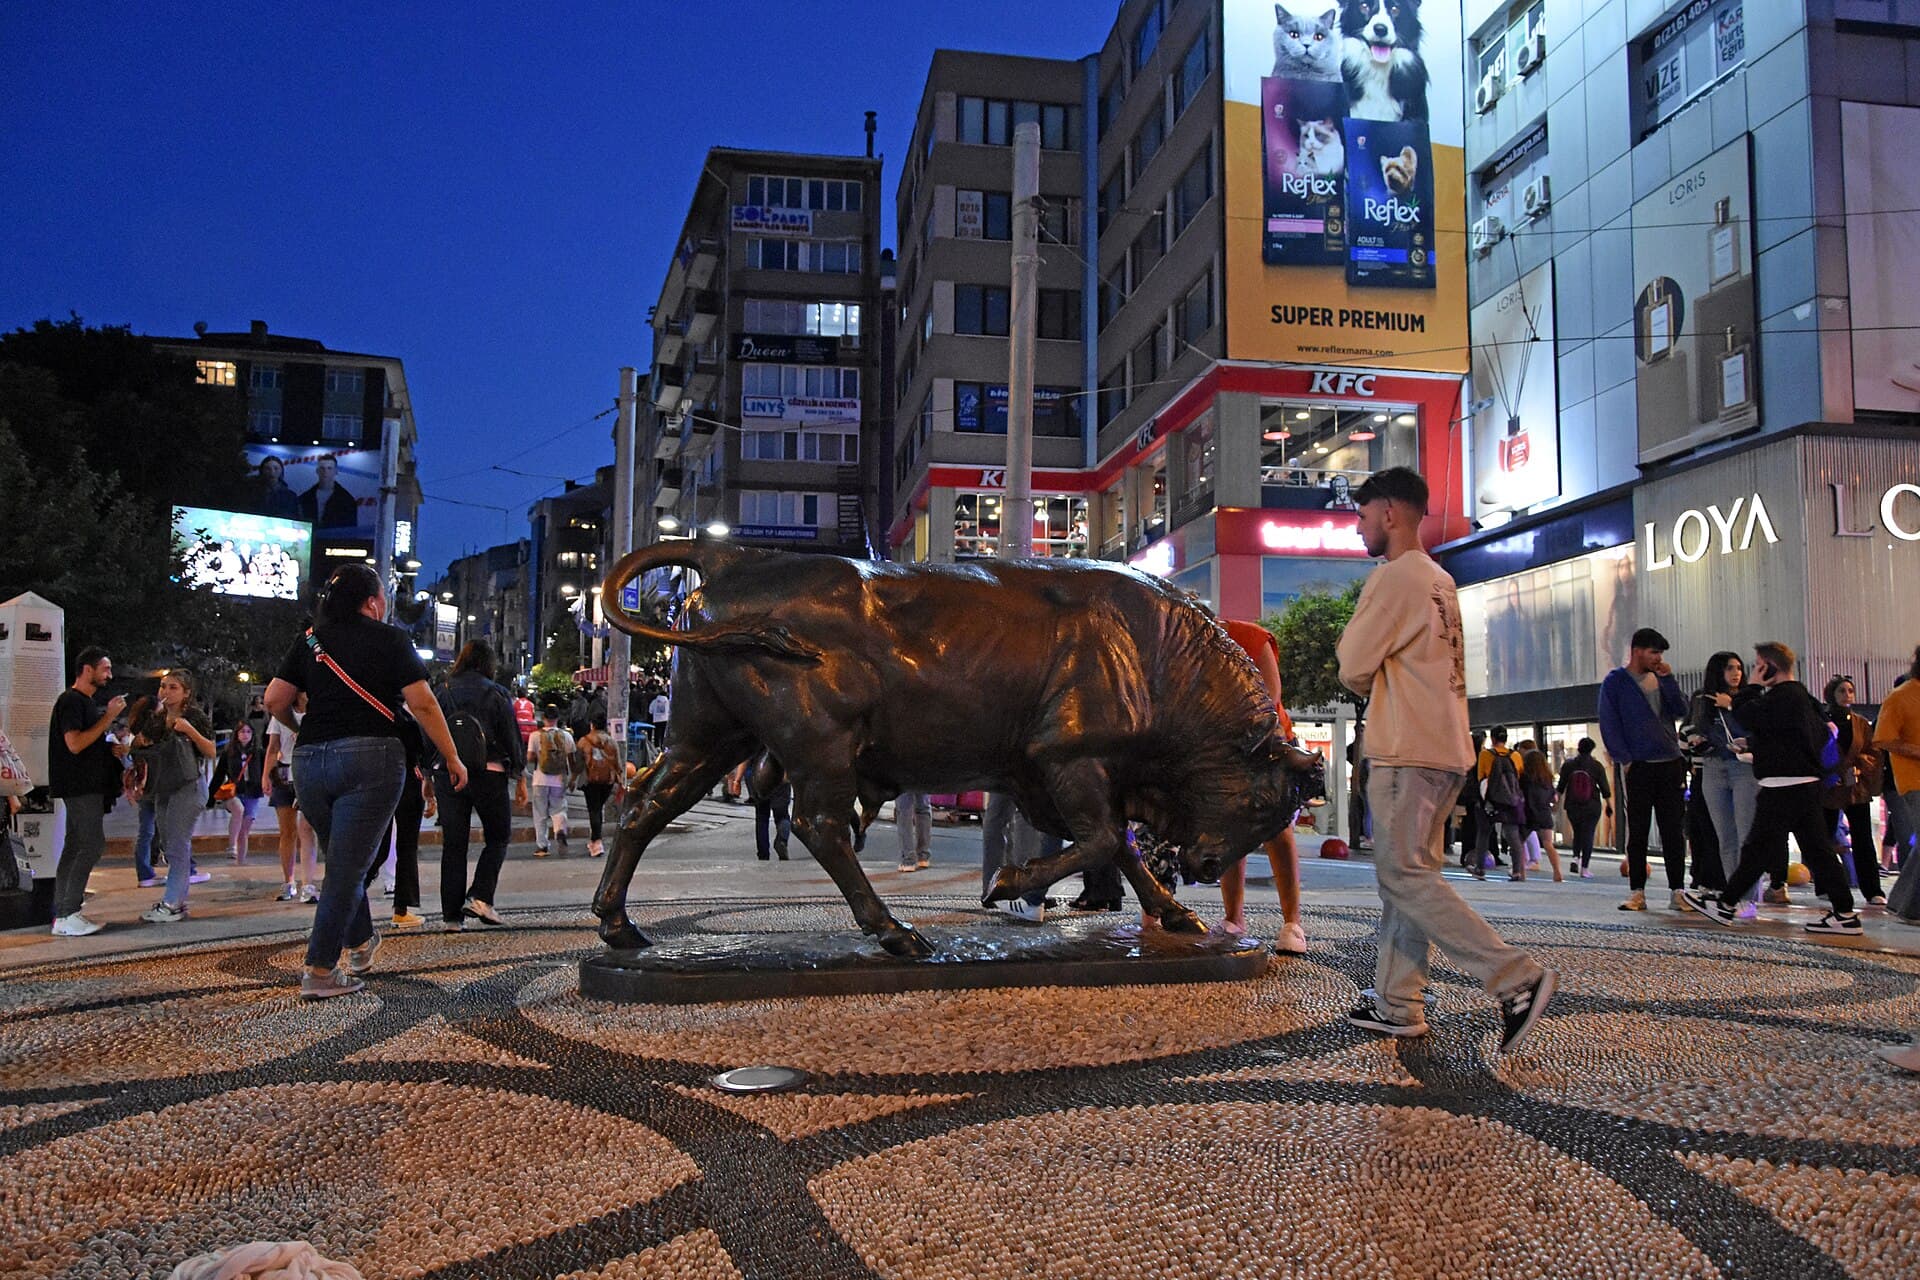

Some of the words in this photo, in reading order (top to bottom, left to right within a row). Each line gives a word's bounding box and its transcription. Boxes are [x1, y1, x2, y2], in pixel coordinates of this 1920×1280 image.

[1282, 172, 1338, 199] Reflex
[1668, 171, 1706, 205] LORIS
[1364, 197, 1421, 226] Reflex
[1271, 304, 1333, 327] SUPER
[1339, 309, 1425, 333] PREMIUM
[738, 338, 787, 360] Queen
[1297, 344, 1394, 357] www.reflexmama.com
[1309, 372, 1377, 397] KFC
[1644, 492, 1782, 572] LOYA
